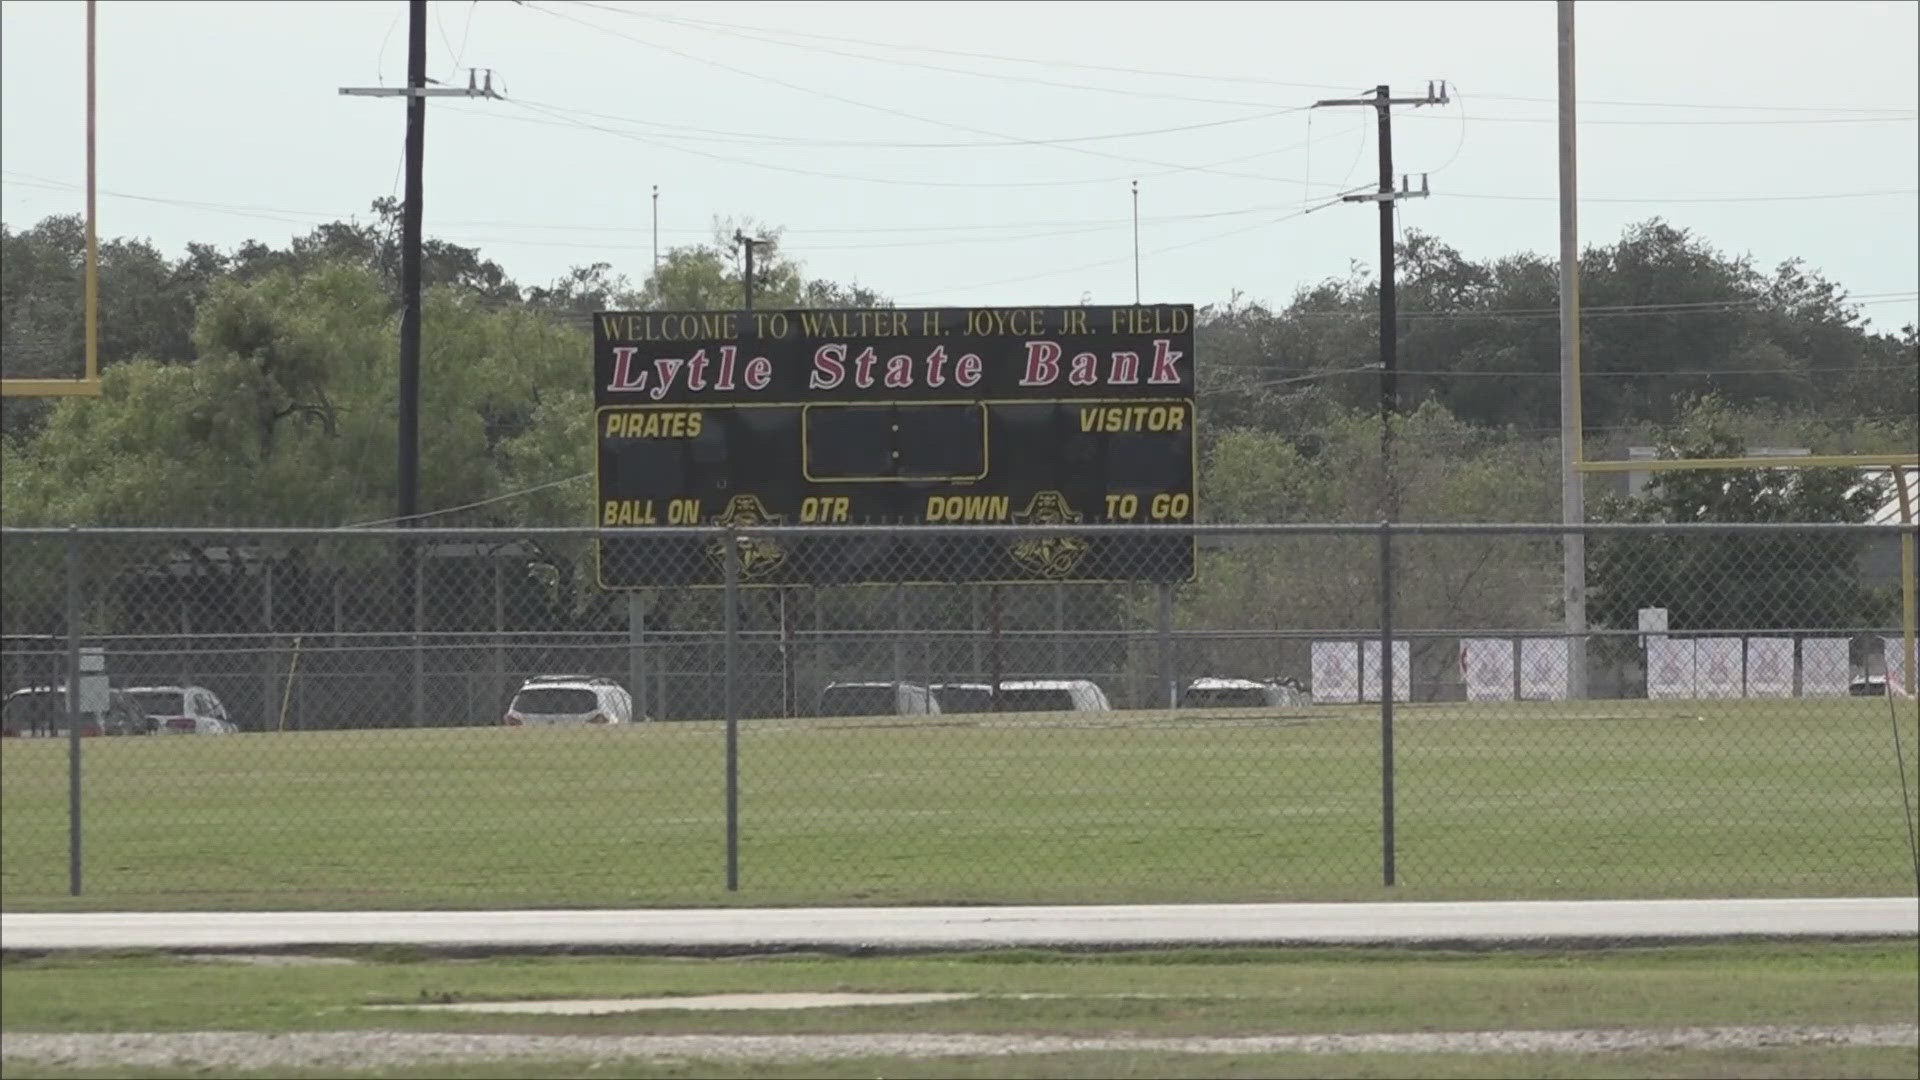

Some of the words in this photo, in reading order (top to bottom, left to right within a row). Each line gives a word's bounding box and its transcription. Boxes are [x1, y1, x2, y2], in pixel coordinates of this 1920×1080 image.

[602, 314, 738, 341] WELCOME
[752, 313, 788, 340] TO
[801, 311, 908, 338] WALTER
[923, 311, 950, 335] H.
[964, 309, 1045, 336] JOYCE
[1058, 309, 1096, 335] JR.
[1111, 308, 1189, 334] FIELD
[607, 345, 772, 400] Lytle
[809, 343, 983, 390] State
[1019, 340, 1183, 386] Bank
[605, 412, 702, 438] PIRATES
[1080, 406, 1185, 432] VISITOR
[604, 500, 657, 525] BALL
[667, 499, 701, 525] ON
[800, 497, 849, 523] QTR
[926, 495, 1009, 521] DOWN
[1105, 494, 1138, 519] TO
[1151, 493, 1190, 518] GO
